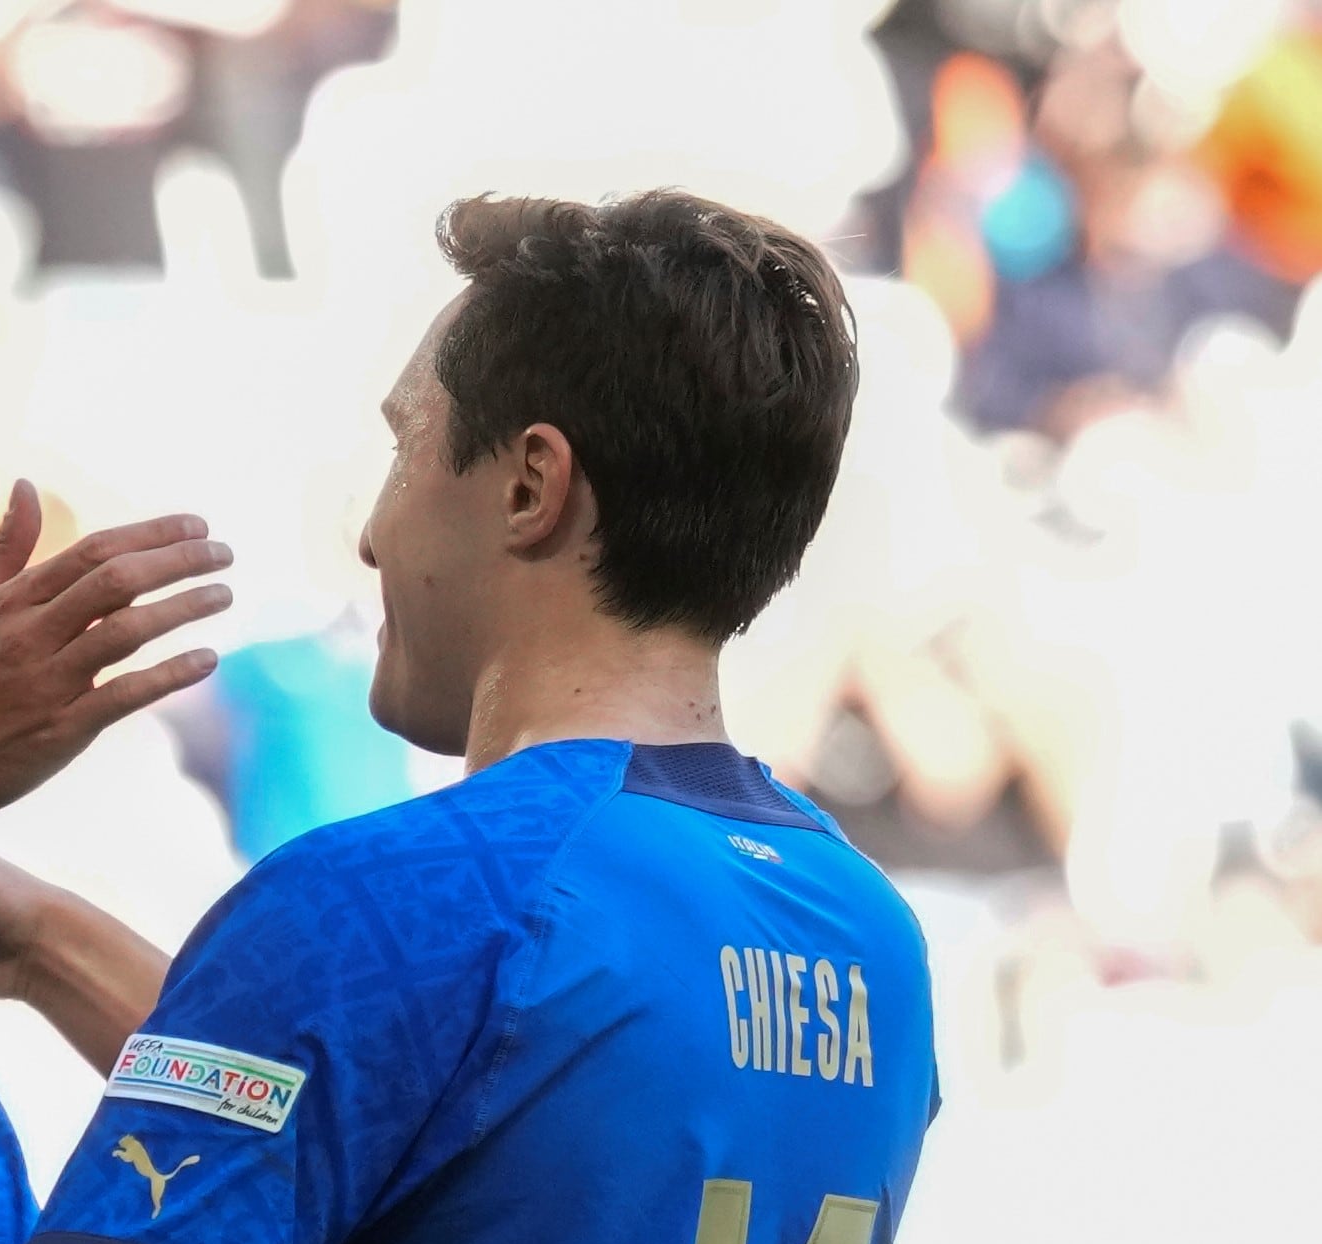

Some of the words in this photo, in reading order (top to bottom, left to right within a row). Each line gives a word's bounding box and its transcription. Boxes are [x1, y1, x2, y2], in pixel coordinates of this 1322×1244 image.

[719, 944, 873, 1087] CHIESA
[127, 1039, 163, 1053] UEFA
[217, 1098, 237, 1112] for
[237, 1105, 279, 1125] children
